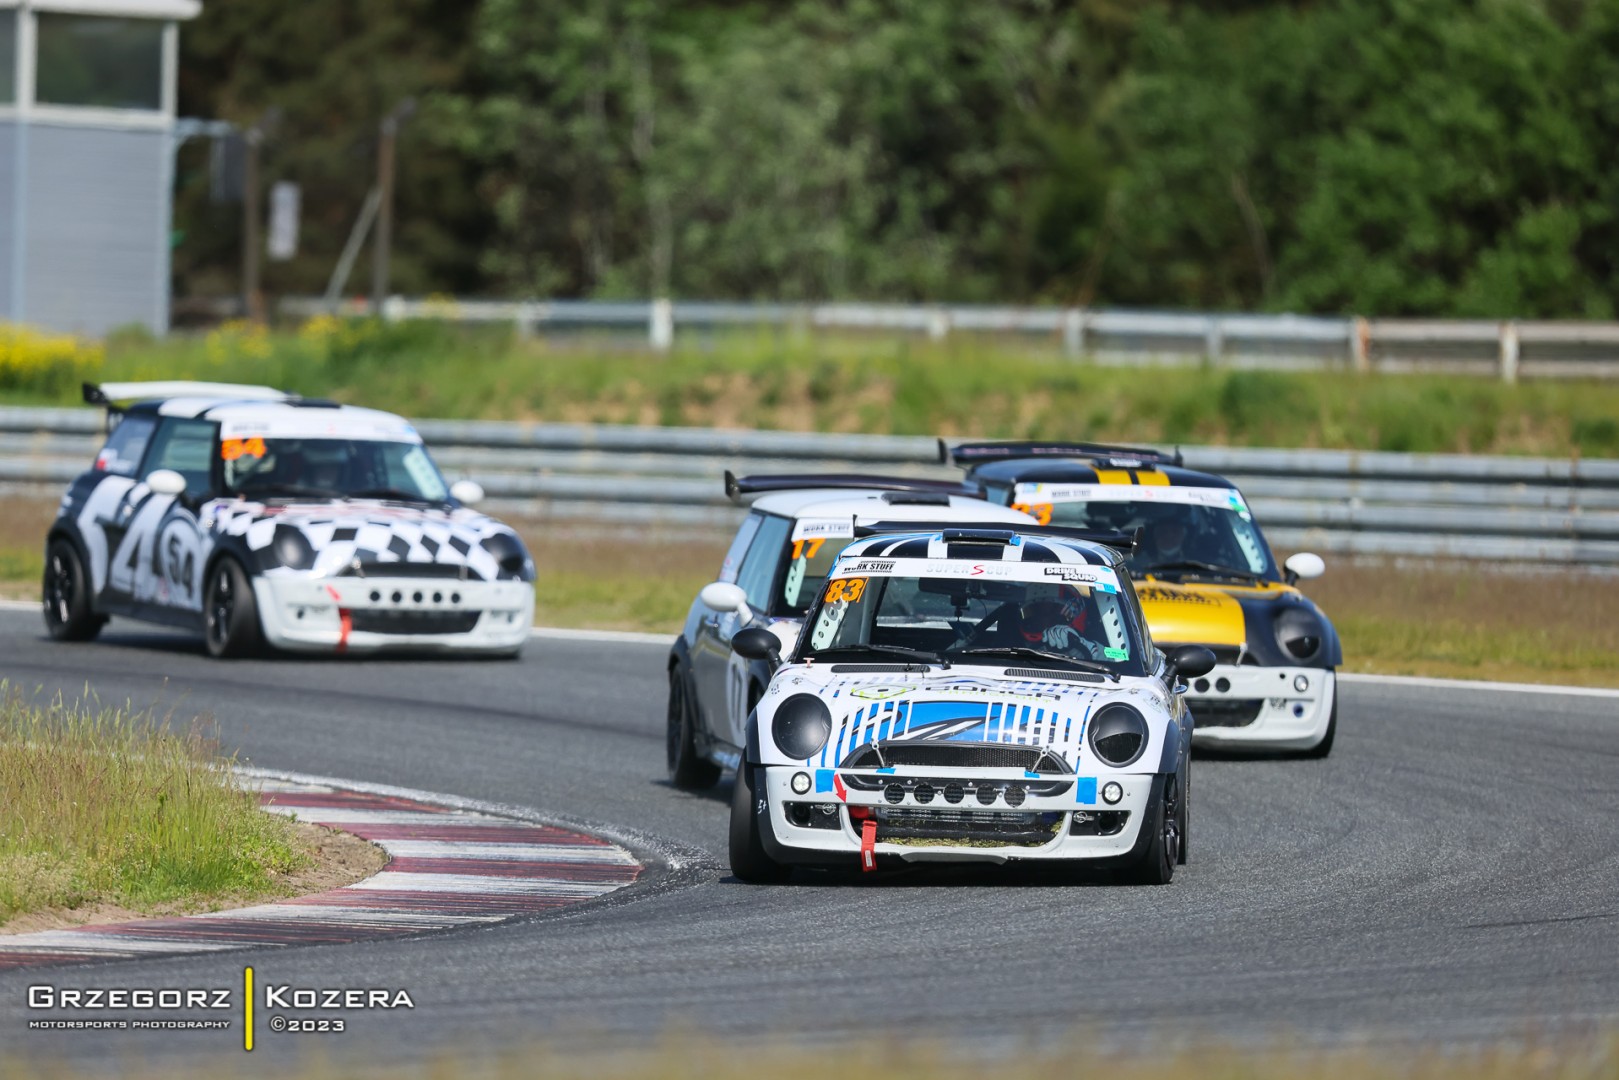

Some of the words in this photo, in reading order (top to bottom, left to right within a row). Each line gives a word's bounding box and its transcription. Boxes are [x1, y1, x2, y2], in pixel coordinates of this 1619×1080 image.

[792, 538, 827, 560] 17
[869, 563, 895, 571] STUFF
[926, 563, 970, 574] SUPER
[986, 565, 1014, 577] CUP
[1044, 567, 1077, 576] DRIVE
[1062, 573, 1098, 582] SQUID
[825, 578, 865, 603] 83
